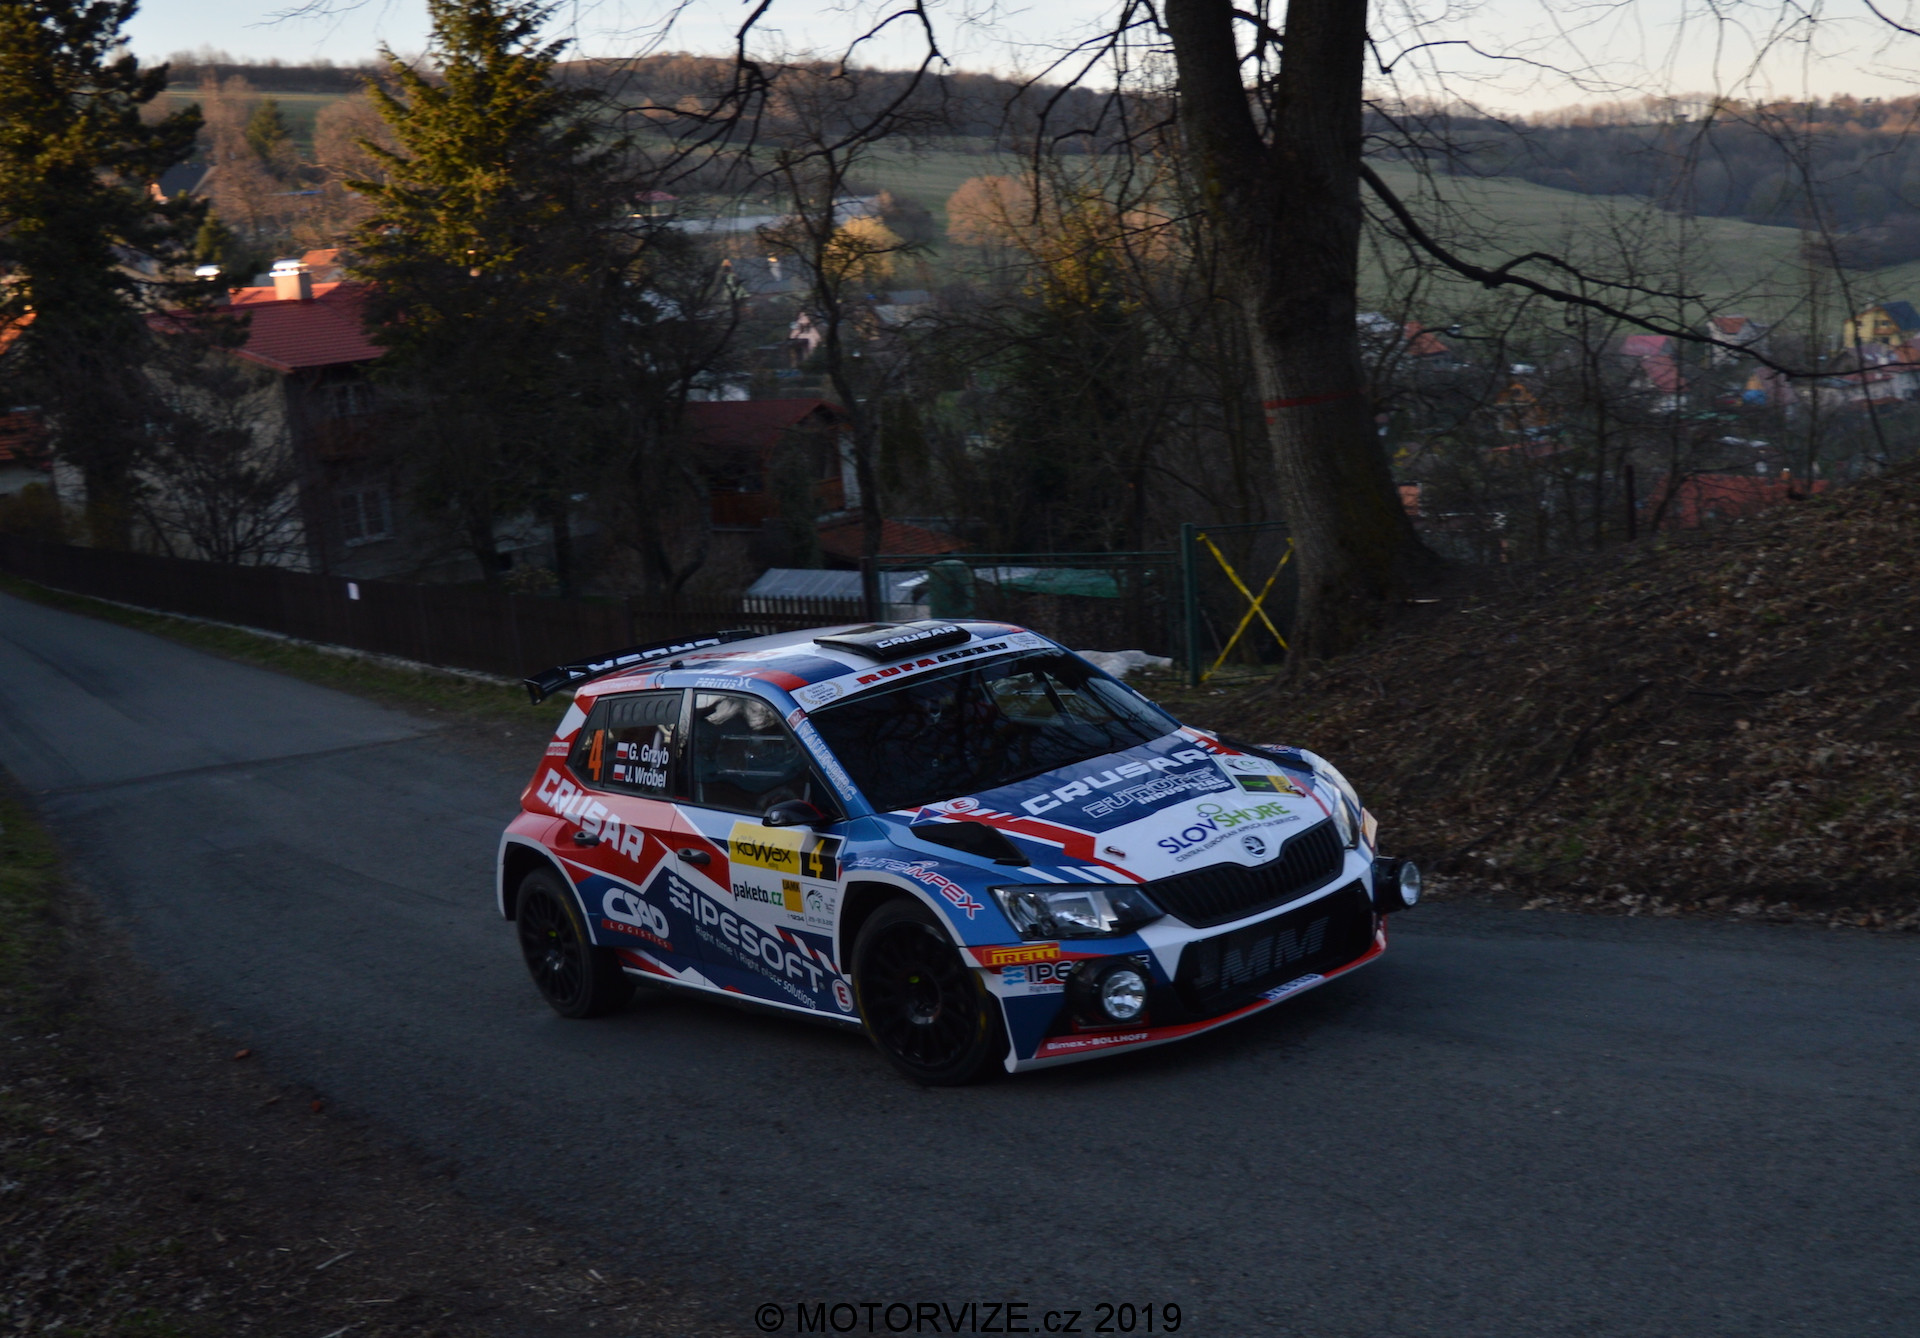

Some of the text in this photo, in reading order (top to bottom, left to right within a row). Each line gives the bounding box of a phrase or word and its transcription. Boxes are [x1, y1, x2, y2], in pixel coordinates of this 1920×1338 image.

[876, 625, 959, 649] CRUSAR
[692, 677, 737, 688] PERITUS
[588, 730, 604, 781] 4
[629, 743, 669, 768] G. Grzyb
[799, 721, 858, 802] WALLENBERG
[625, 765, 667, 788] J. Wróbel
[1020, 748, 1212, 816] CRUSAR
[536, 768, 645, 863] CRUSAR
[808, 839, 826, 879] 4
[602, 887, 670, 939] CSAD
[733, 881, 784, 907] paketo.cz
[609, 922, 668, 948] LOGISTICS
[692, 892, 824, 994] IPESOFT
[695, 924, 715, 945] Right
[783, 981, 817, 1010] solutions
[837, 986, 849, 1004] E
